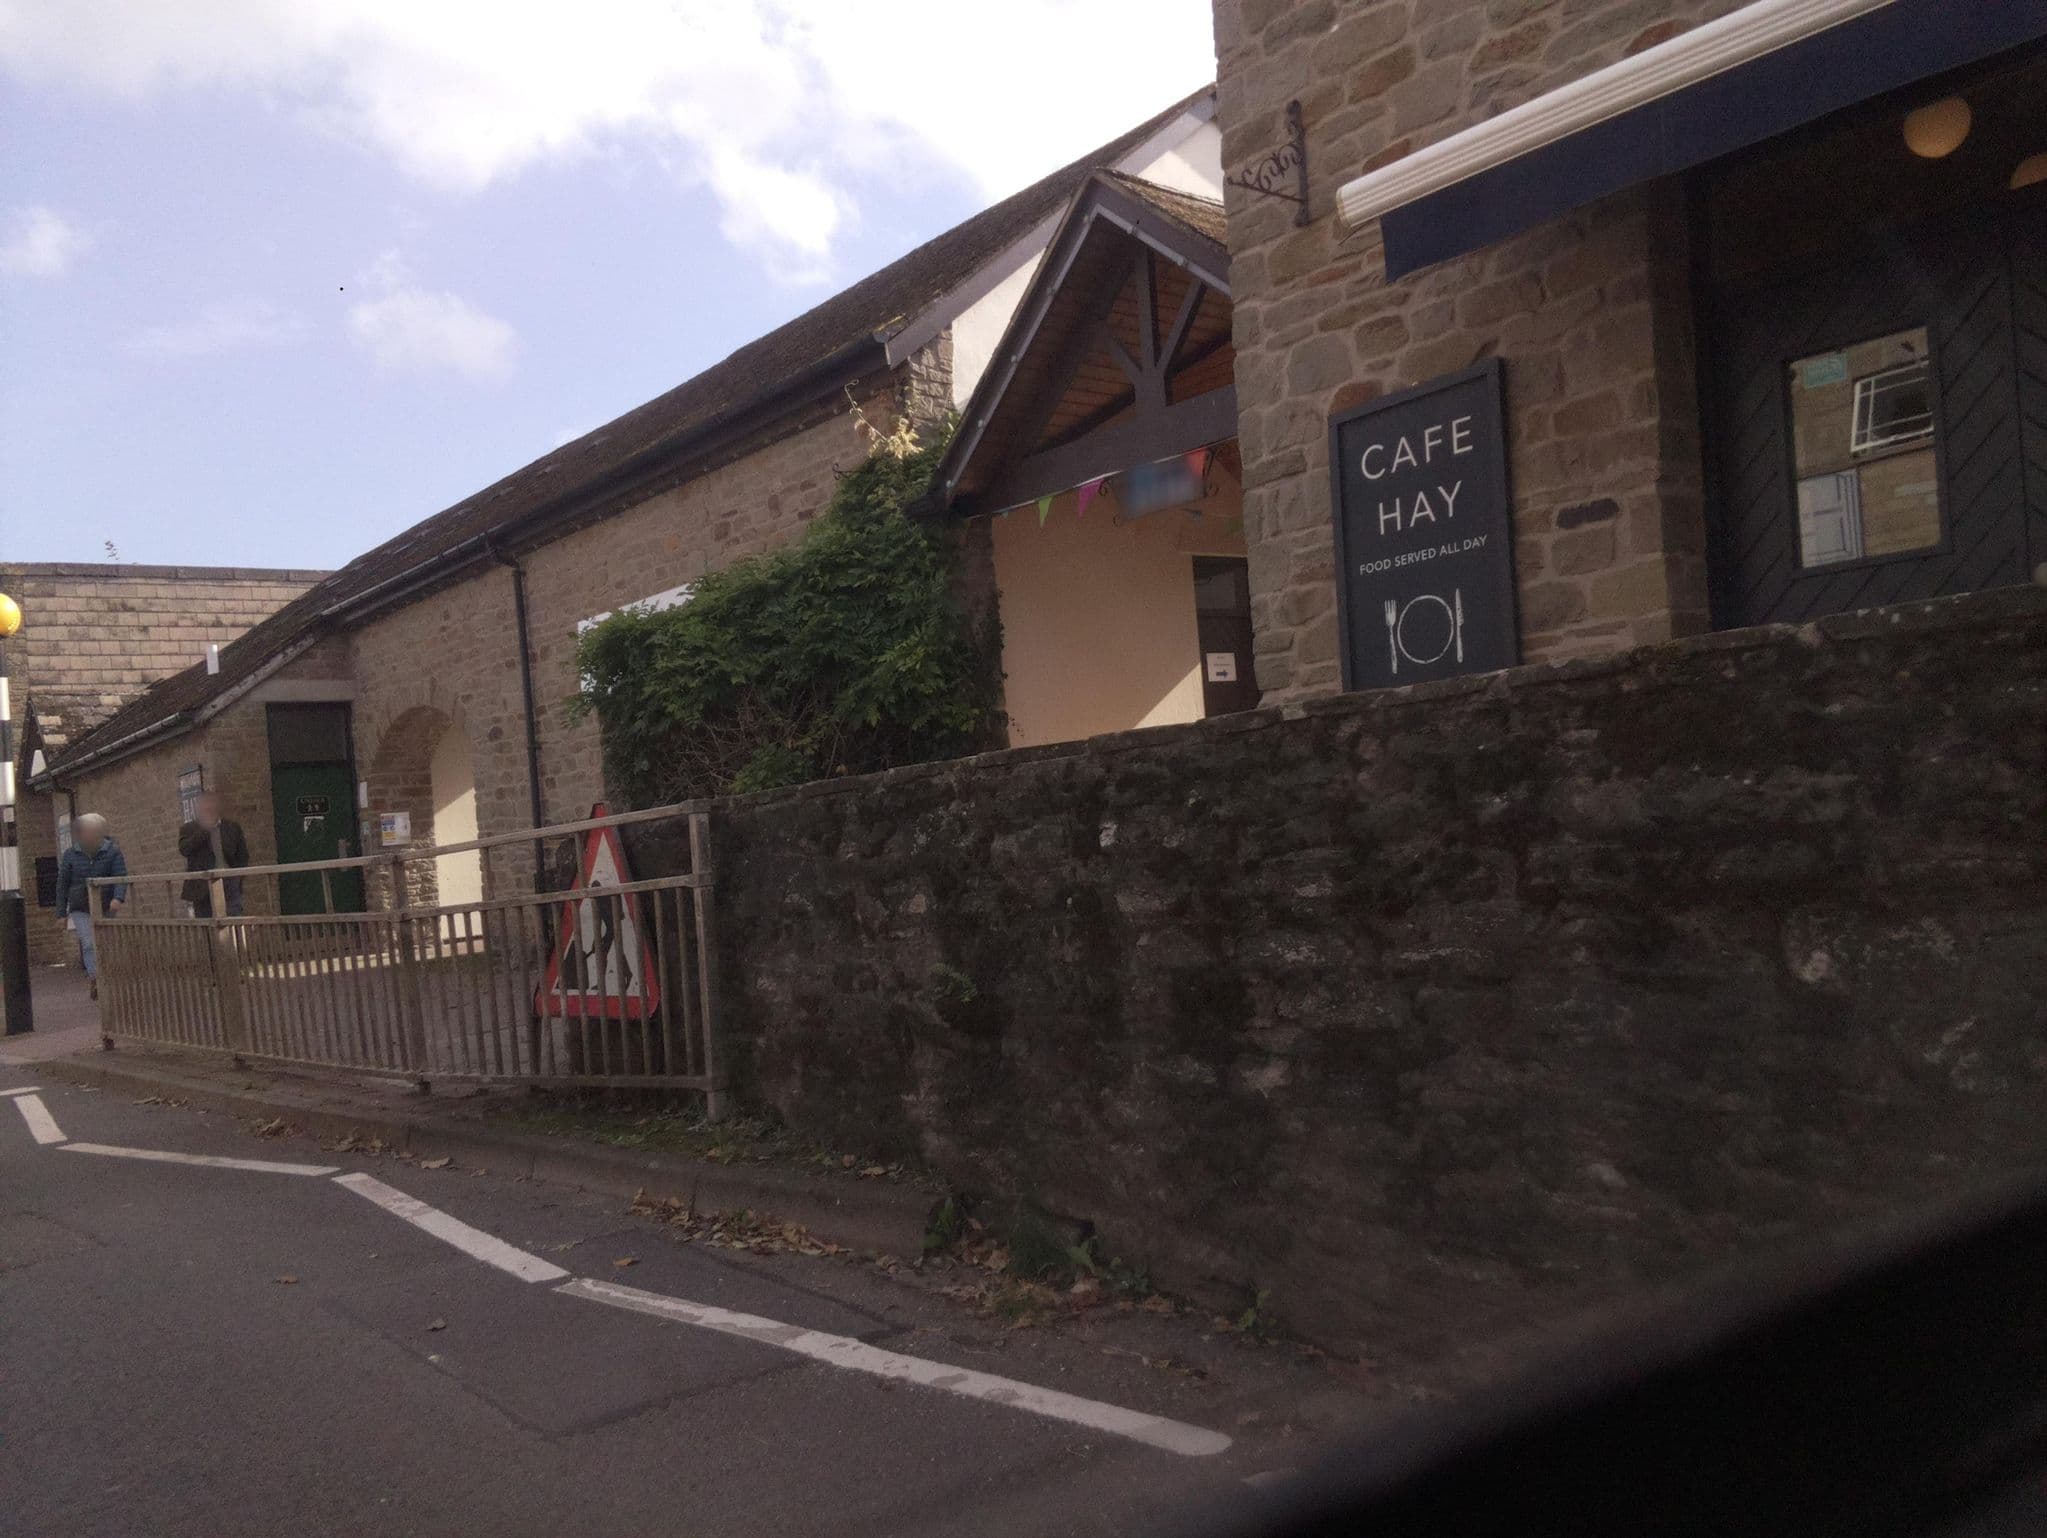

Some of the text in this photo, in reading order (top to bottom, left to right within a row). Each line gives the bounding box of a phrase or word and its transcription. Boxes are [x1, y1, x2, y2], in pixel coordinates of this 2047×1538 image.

[1361, 416, 1473, 479] CAFE
[1378, 480, 1462, 535] HAY
[1359, 535, 1487, 575] FOOD SERVED ALL DAY
